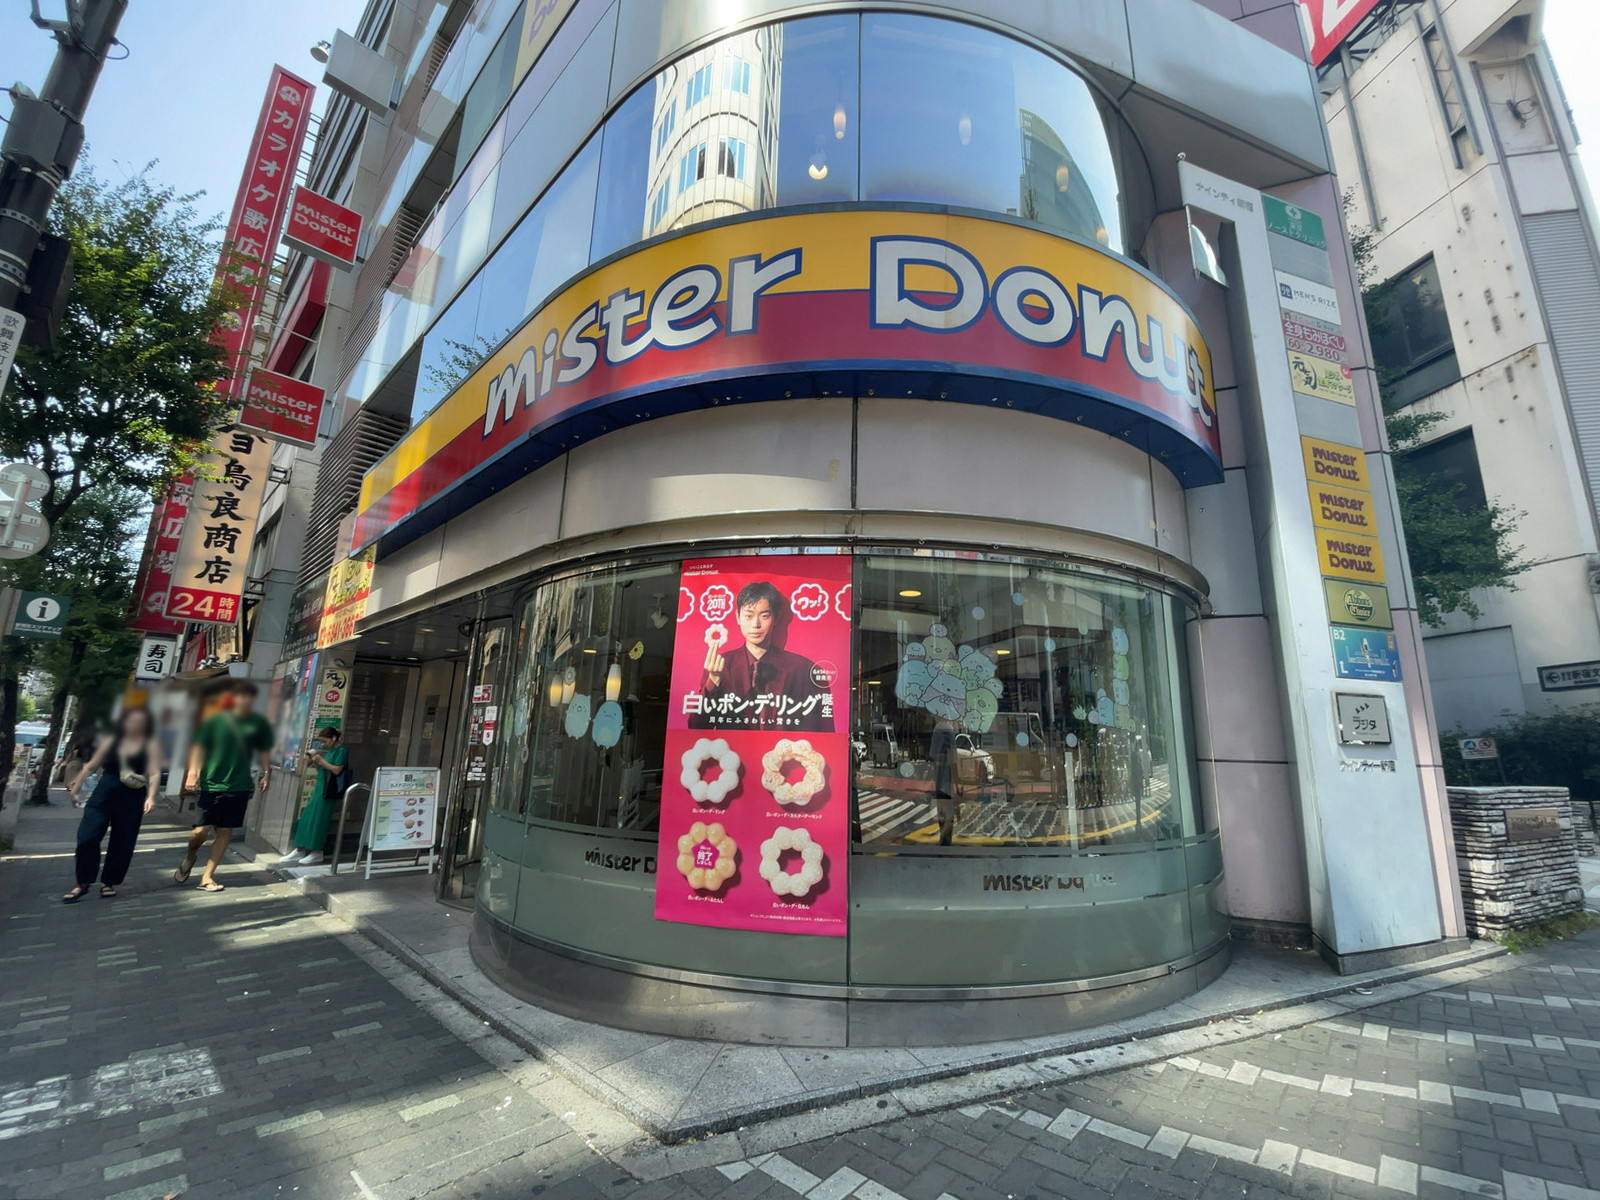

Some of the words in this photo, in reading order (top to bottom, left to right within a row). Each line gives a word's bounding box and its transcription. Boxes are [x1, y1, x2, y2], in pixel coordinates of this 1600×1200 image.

[294, 213, 354, 247] Donut
[1293, 290, 1316, 302] MEN'S
[1318, 297, 1337, 309] RIZE
[868, 235, 1214, 430] Donut
[1284, 321, 1345, 350] 全身もみほぐし
[1314, 460, 1360, 481] Donut
[1321, 506, 1368, 527] Donut
[1328, 553, 1375, 573] Donut
[171, 592, 235, 622] 24時間
[1333, 629, 1346, 641] B2
[144, 644, 168, 674] 寿司
[821, 693, 834, 718] 誕生
[1353, 720, 1377, 730] フジタ
